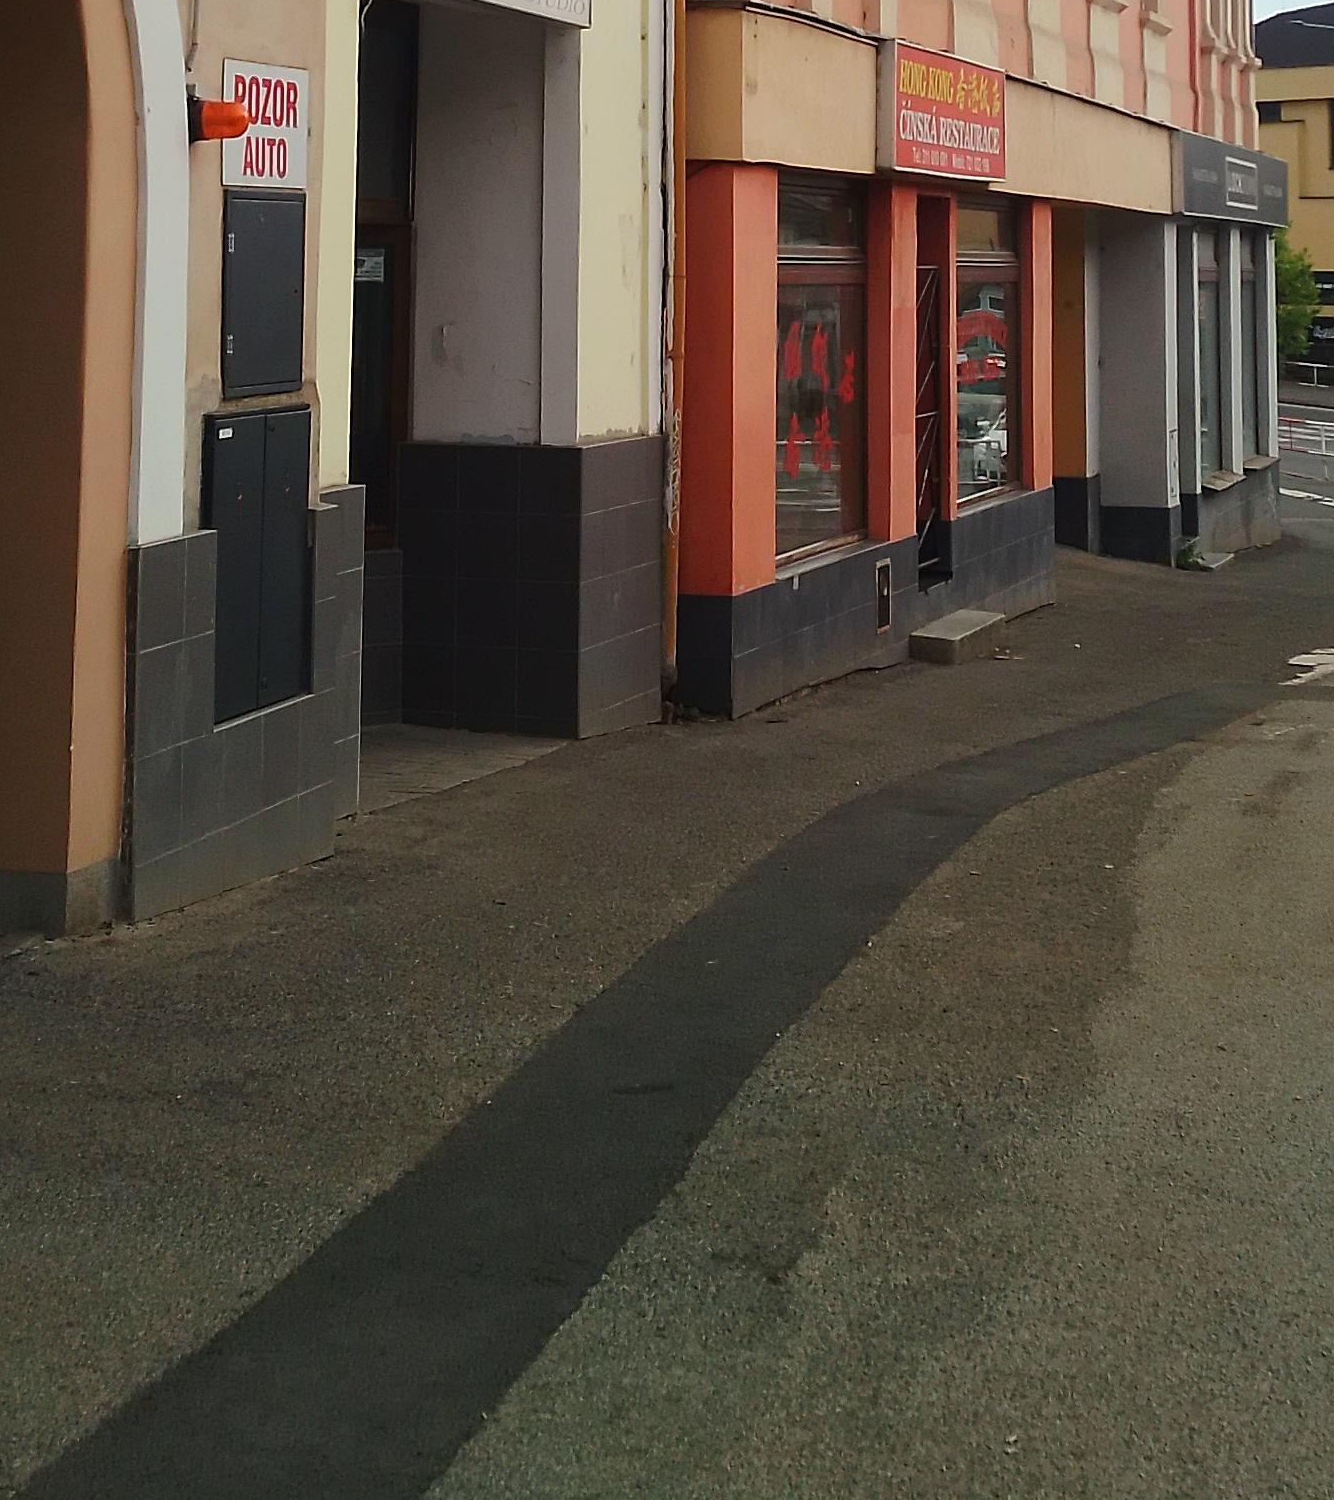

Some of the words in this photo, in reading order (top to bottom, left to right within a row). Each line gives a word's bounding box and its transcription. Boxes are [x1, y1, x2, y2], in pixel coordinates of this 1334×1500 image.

[234, 74, 299, 129] POZOR
[899, 59, 927, 98] HONG
[928, 66, 954, 104] KONG
[899, 100, 937, 145] ČÍNSKÁ
[939, 116, 1000, 155] RESTAURACE
[242, 135, 287, 180] AUTO
